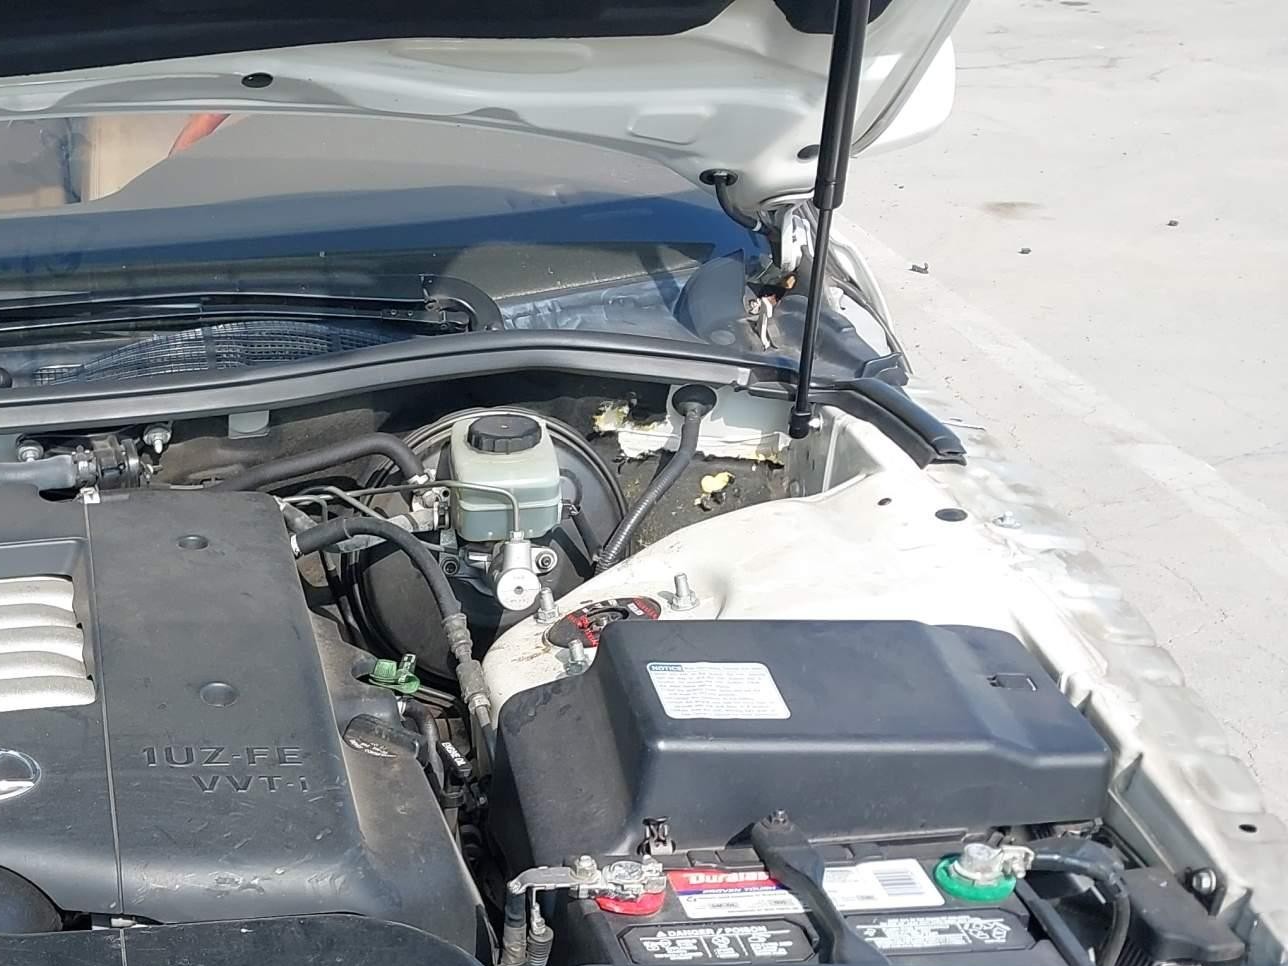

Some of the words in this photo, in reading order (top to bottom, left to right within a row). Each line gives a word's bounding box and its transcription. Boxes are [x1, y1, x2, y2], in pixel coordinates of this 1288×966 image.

[142, 745, 304, 768] 1UZ-FE
[682, 871, 770, 885] Duralas
[666, 928, 717, 937] DANGER
